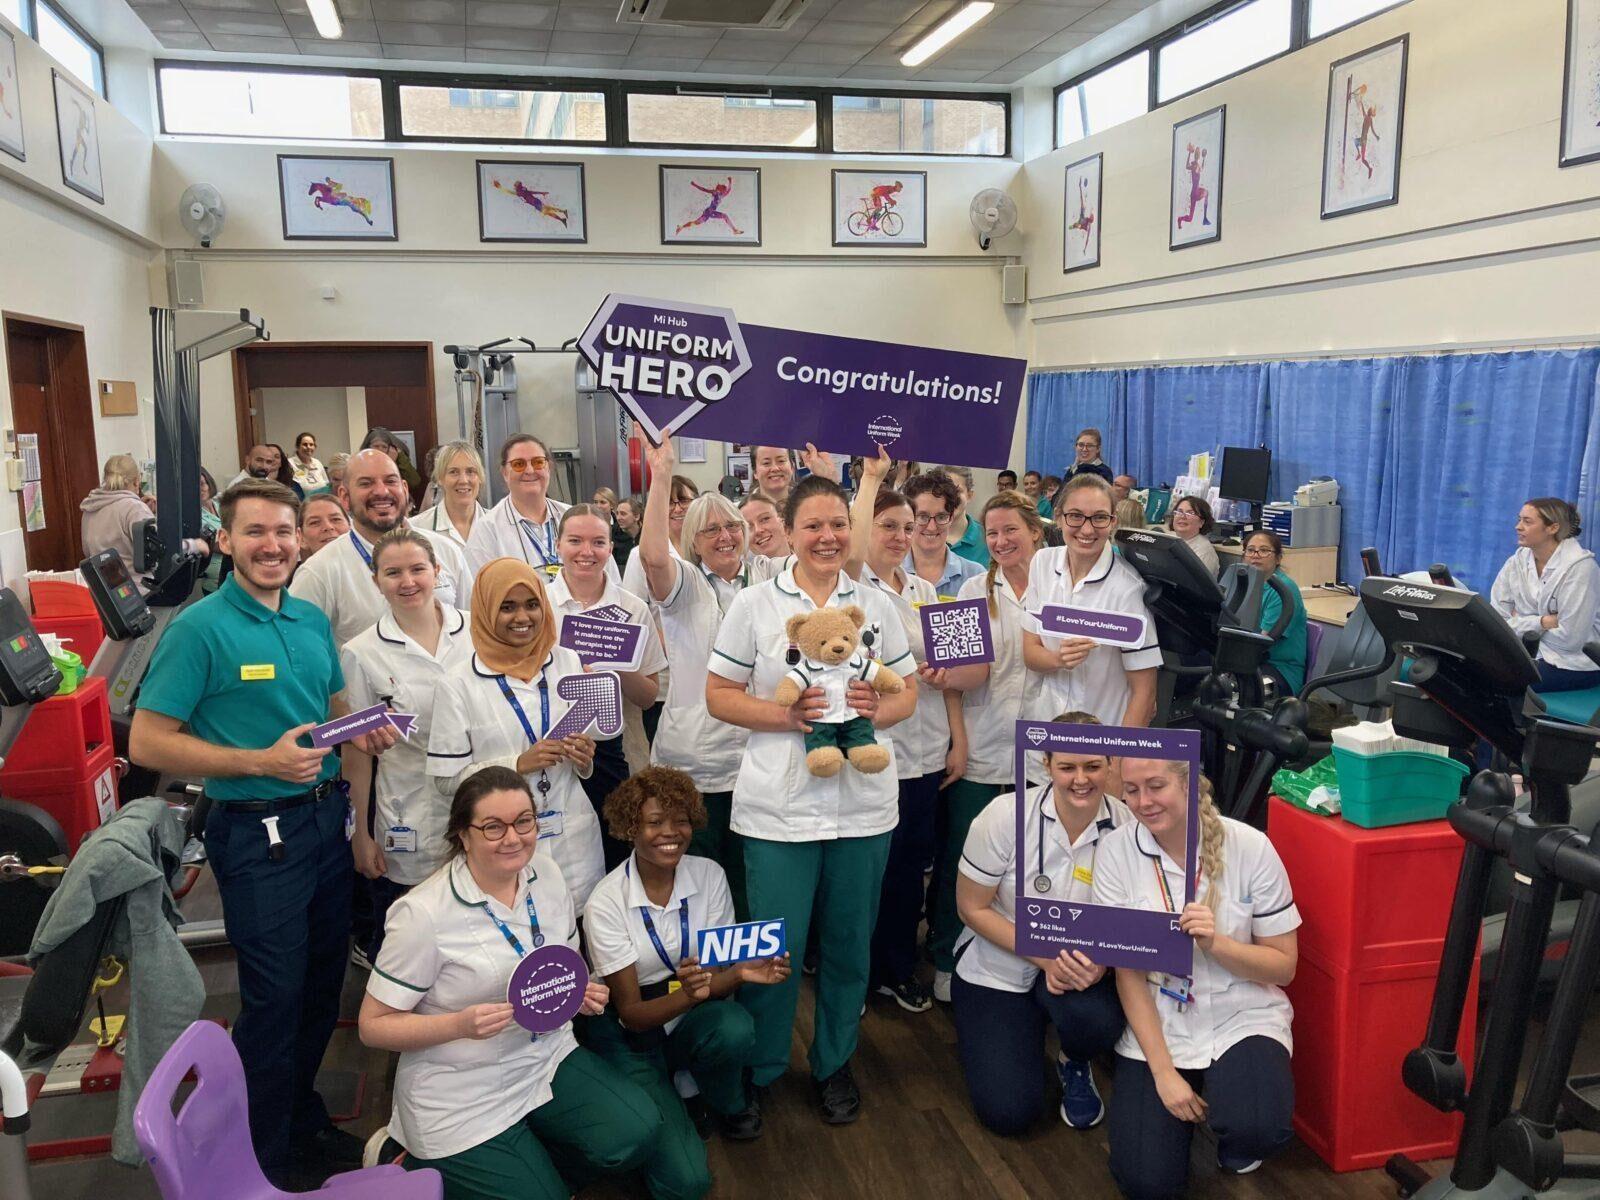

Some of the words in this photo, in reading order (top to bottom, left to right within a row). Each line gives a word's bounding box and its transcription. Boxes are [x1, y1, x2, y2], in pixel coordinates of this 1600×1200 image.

[654, 314, 665, 324] Mi
[667, 316, 688, 327] Hub
[605, 324, 733, 360] UNIFORM
[600, 352, 733, 401] HERO
[777, 356, 1002, 405] Congratulations!
[868, 424, 902, 432] International
[578, 621, 592, 629] love
[592, 623, 603, 631] my
[604, 625, 631, 634] uniform.
[1056, 614, 1128, 632] #LoveYourUniform
[574, 639, 603, 649] therapist
[580, 631, 601, 640] makes
[321, 713, 382, 739] uniformweek.com
[1050, 733, 1102, 745] International
[1103, 737, 1137, 747] Uniform
[1138, 739, 1162, 748] Week
[1051, 924, 1066, 932] likes
[700, 922, 782, 965] NHS
[1047, 935, 1095, 946] #UniformHero!
[1098, 941, 1158, 954] #LoveYourUniform
[520, 970, 576, 997] International
[522, 989, 554, 1007] Uniform
[553, 981, 577, 995] Week
